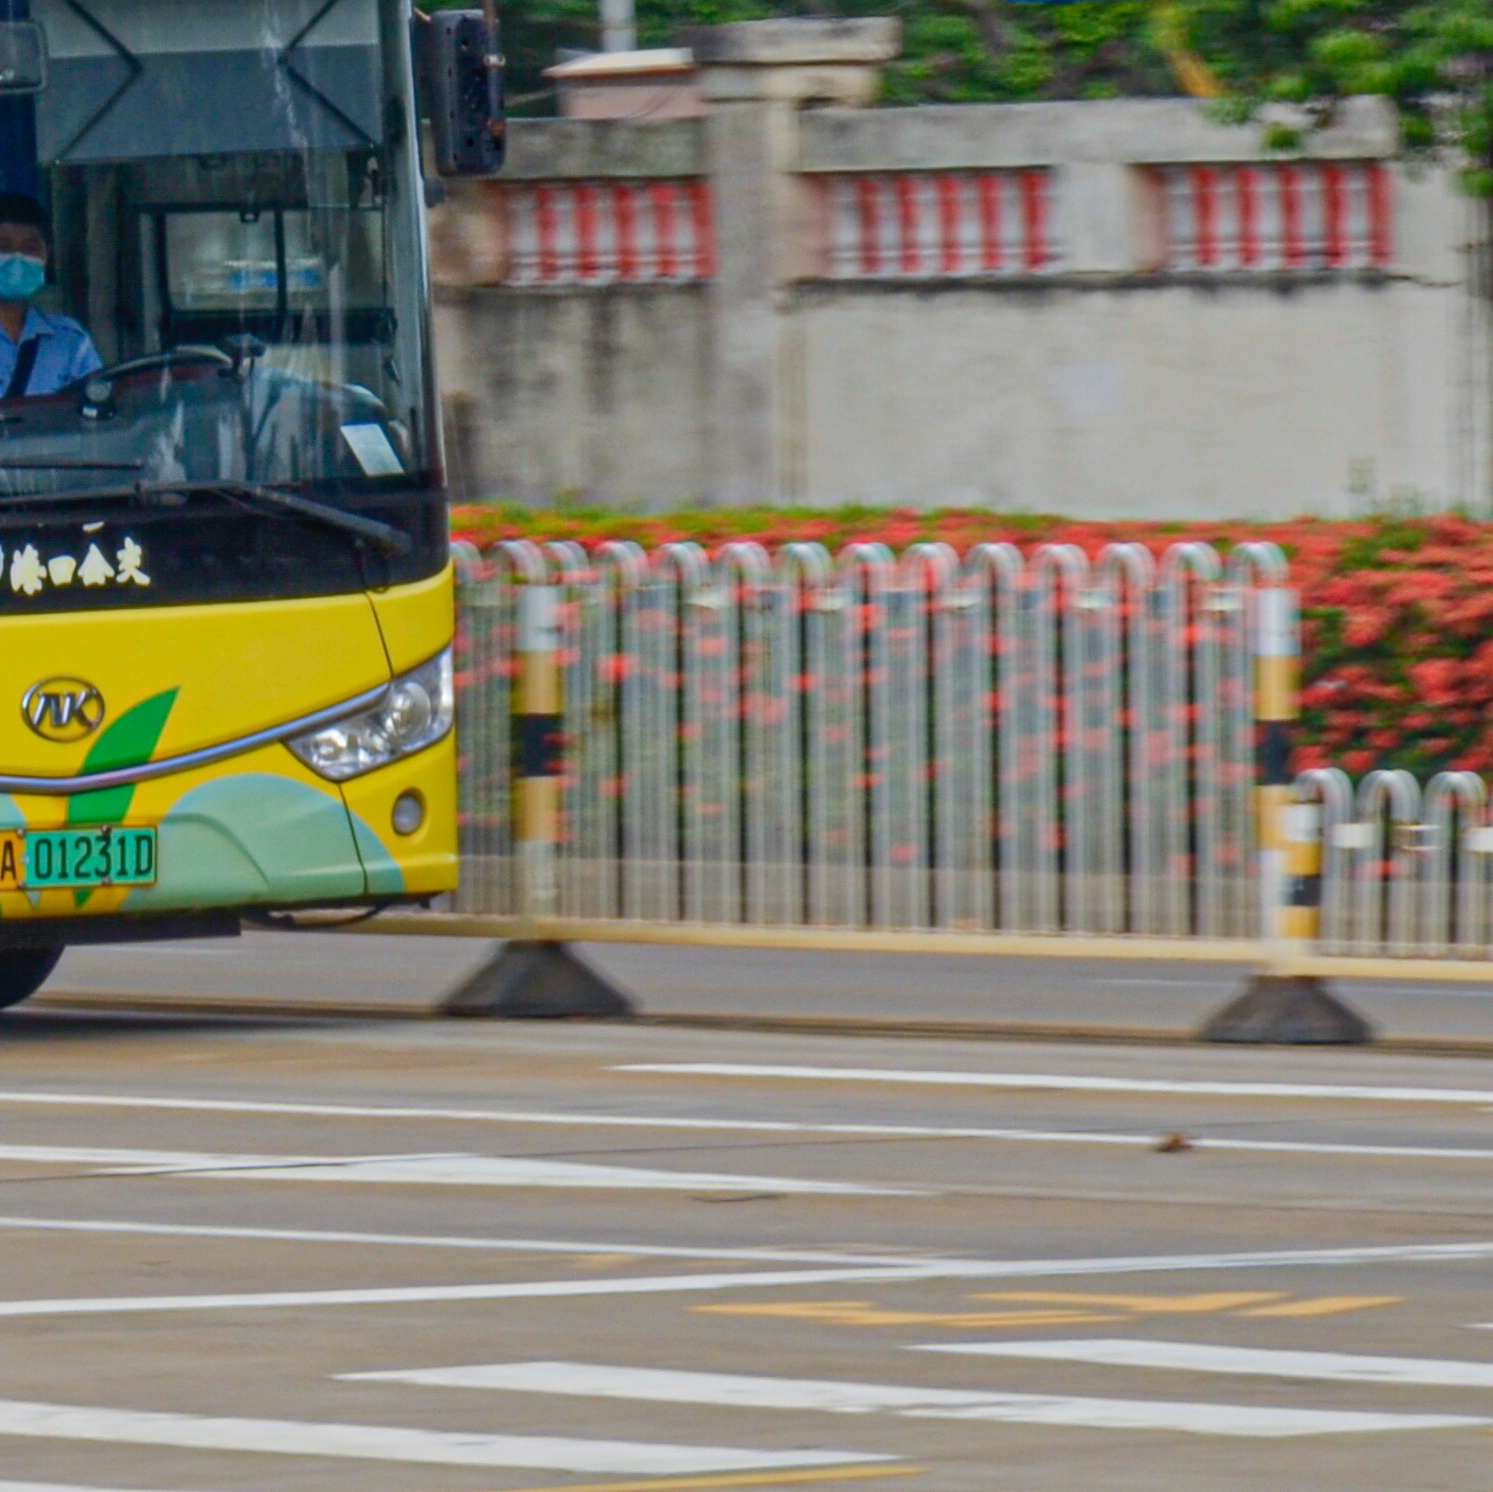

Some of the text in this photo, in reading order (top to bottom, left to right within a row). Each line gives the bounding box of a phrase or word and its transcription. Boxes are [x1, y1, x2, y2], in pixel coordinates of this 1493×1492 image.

[11, 536, 151, 596] 海口公交
[34, 834, 153, 881] 01231D
